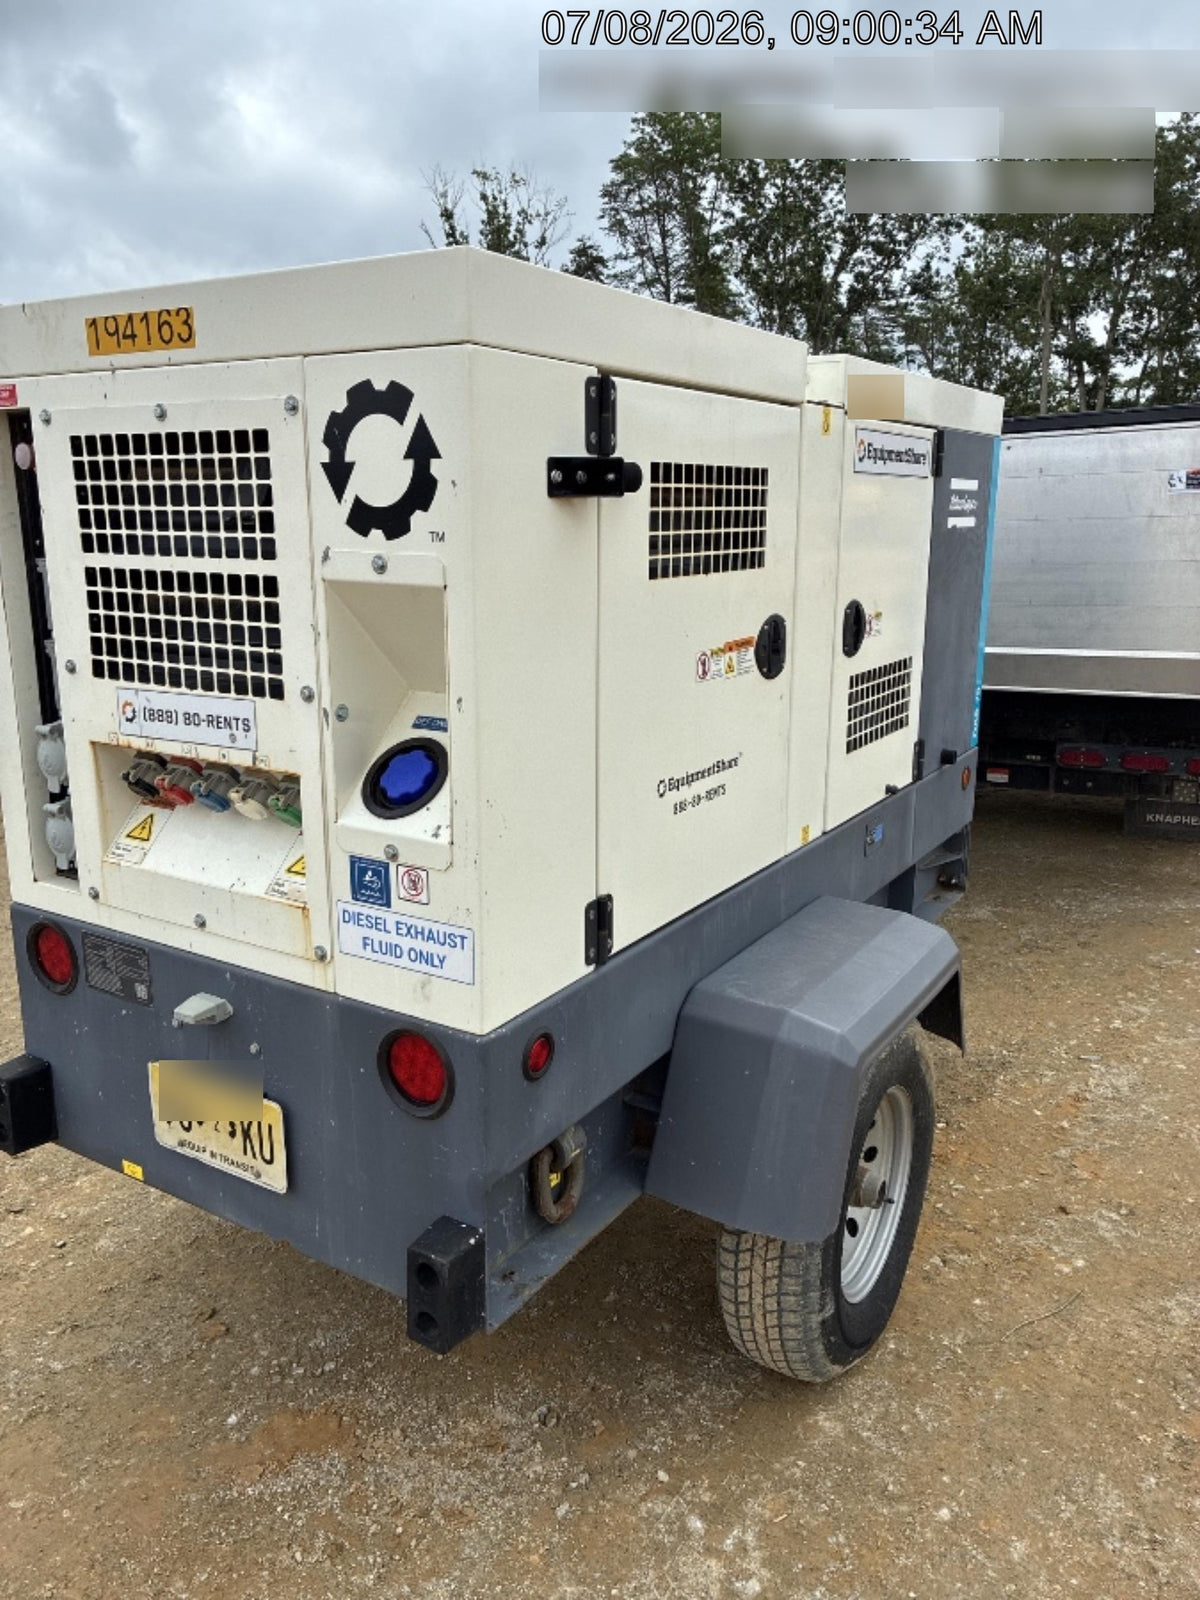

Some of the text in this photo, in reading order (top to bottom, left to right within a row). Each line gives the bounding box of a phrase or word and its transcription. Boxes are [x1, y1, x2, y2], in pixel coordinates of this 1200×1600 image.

[88, 307, 193, 350] 194163
[428, 531, 445, 543] TM
[143, 706, 251, 733] (888) 80-RENTS
[342, 909, 468, 951] DIESEL EXHAUST
[362, 936, 447, 970] FLUID ONLY
